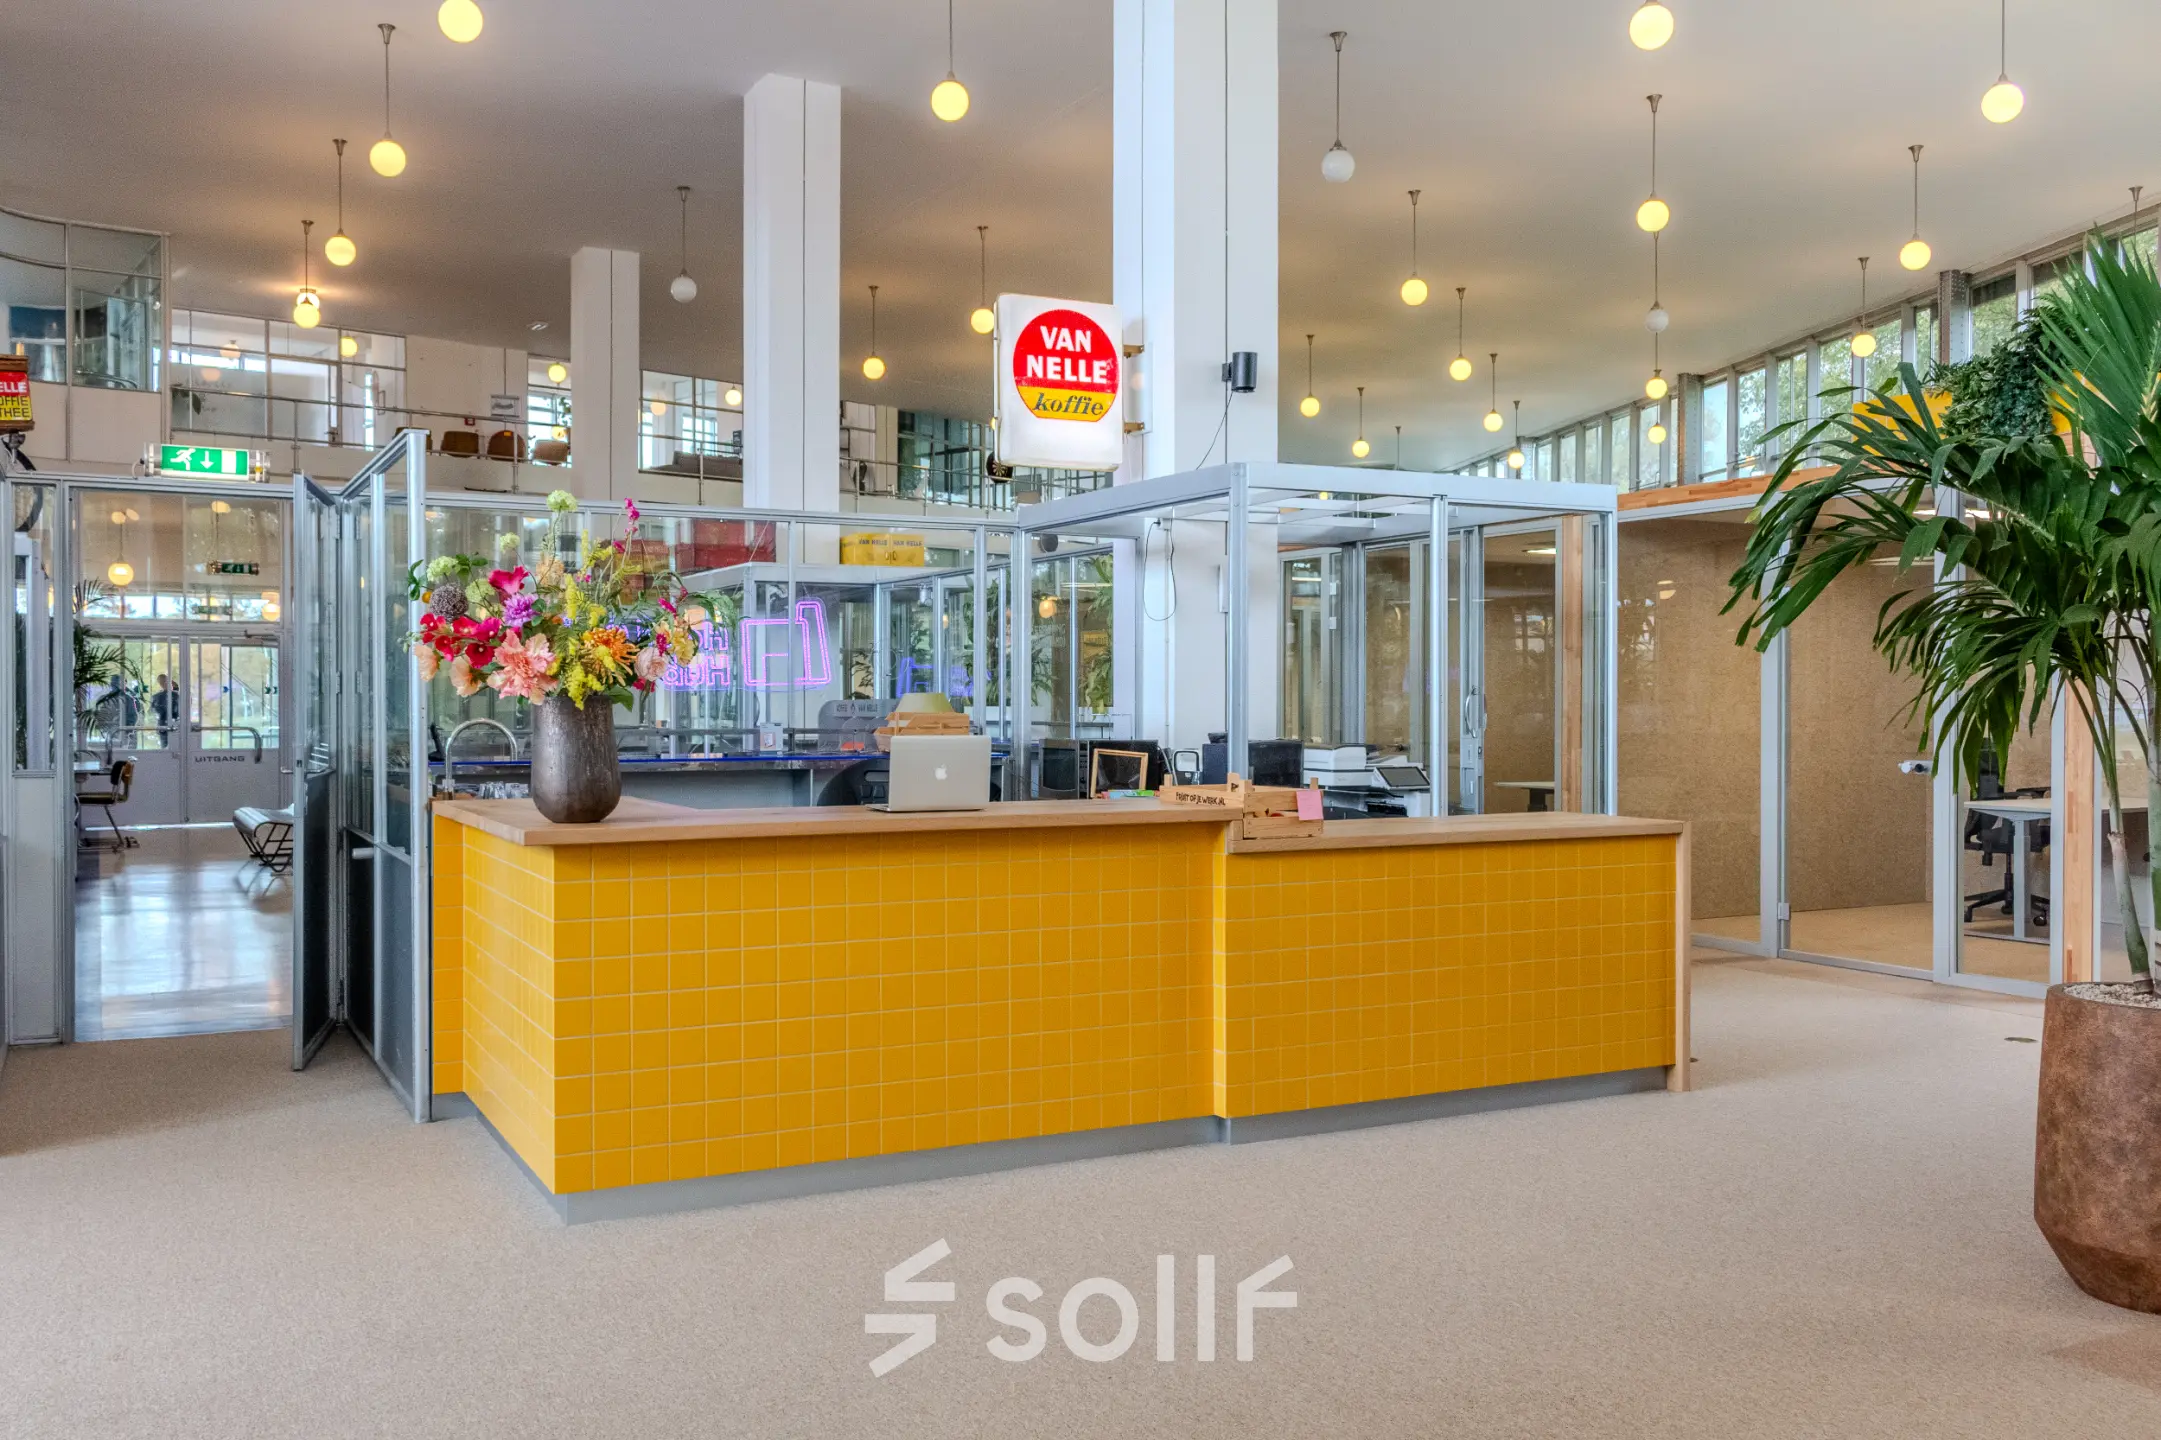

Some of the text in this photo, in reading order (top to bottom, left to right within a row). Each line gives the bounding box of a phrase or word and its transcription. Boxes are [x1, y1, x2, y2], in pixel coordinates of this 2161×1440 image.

[1040, 325, 1092, 353] VAN
[1026, 354, 1107, 385] NELLE
[1032, 392, 1104, 416] koffie
[194, 755, 245, 763] UITGANG
